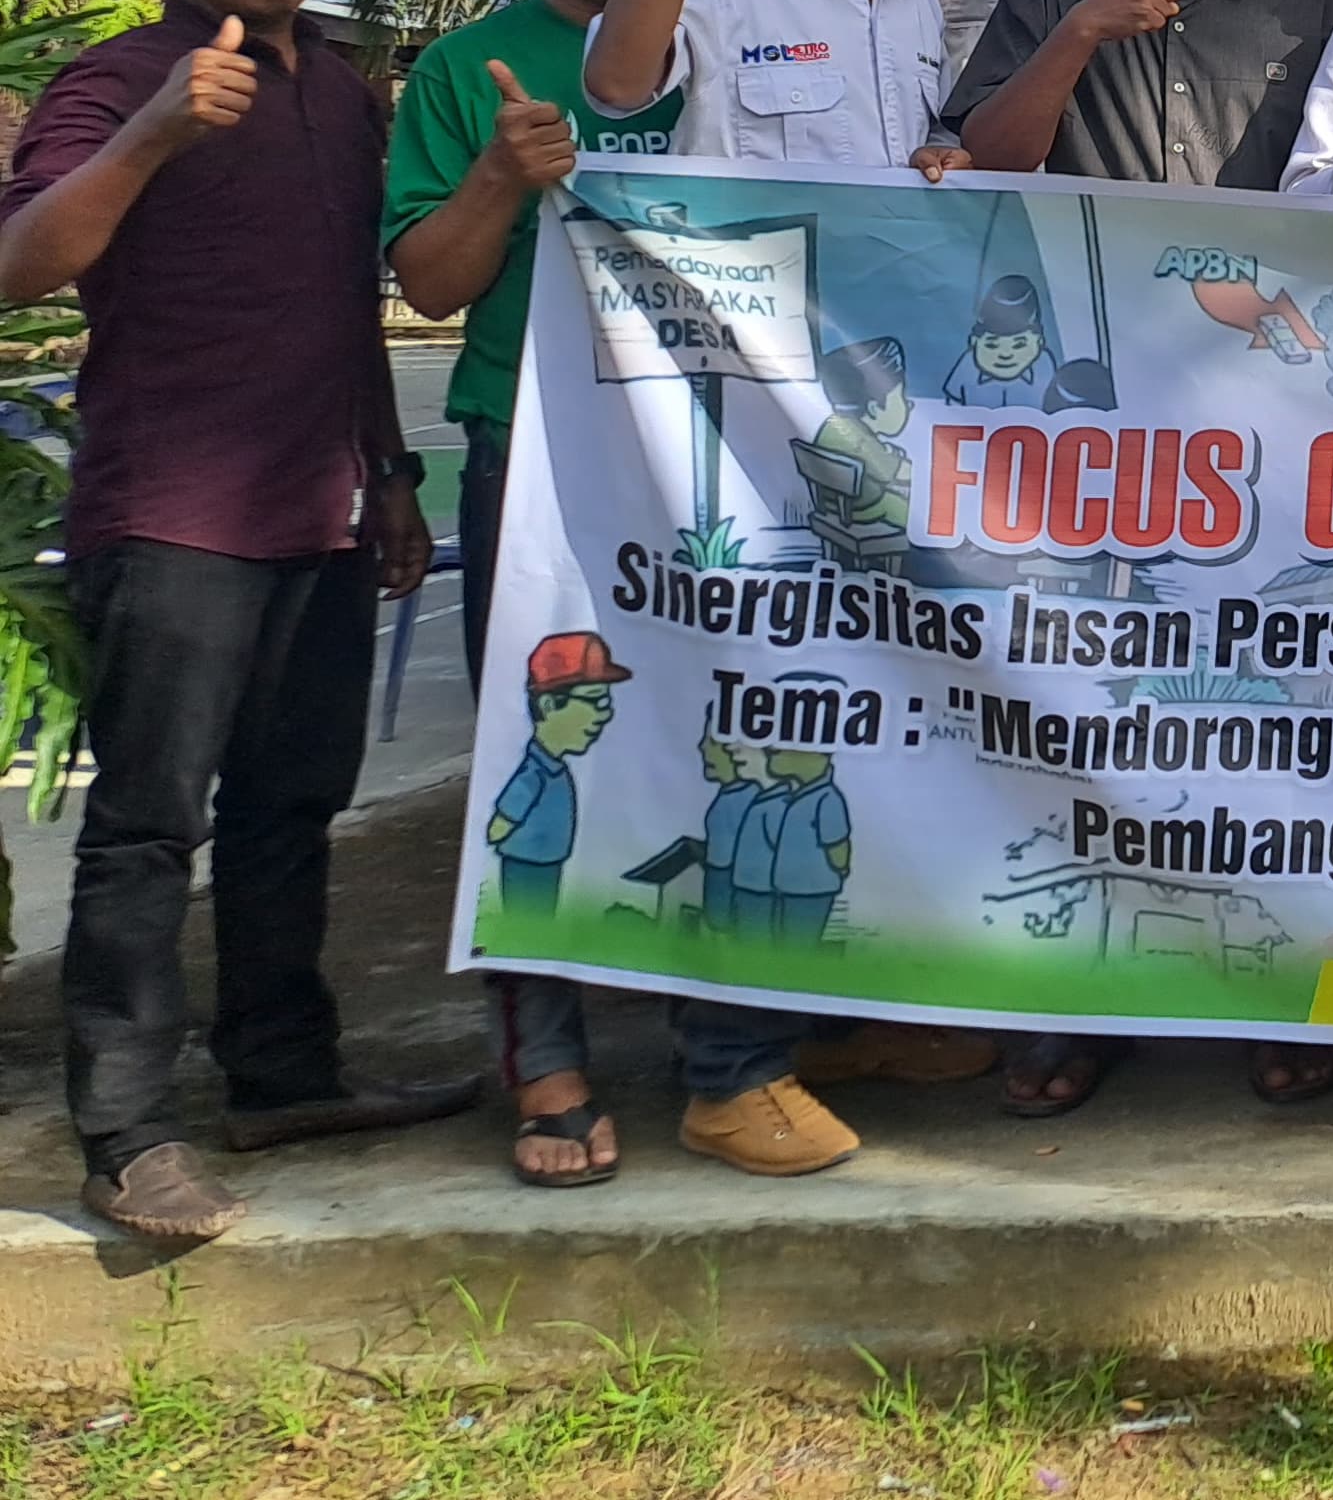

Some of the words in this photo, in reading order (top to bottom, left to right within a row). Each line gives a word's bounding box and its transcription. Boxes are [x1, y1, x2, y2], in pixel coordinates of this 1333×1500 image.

[741, 44, 794, 63] MSL
[1154, 245, 1258, 284] APBN
[658, 318, 741, 354] DESA
[927, 423, 1244, 546] FOCUS
[612, 540, 984, 660] Sinergisitas
[1007, 593, 1192, 668] Insan
[710, 669, 881, 747] Tema
